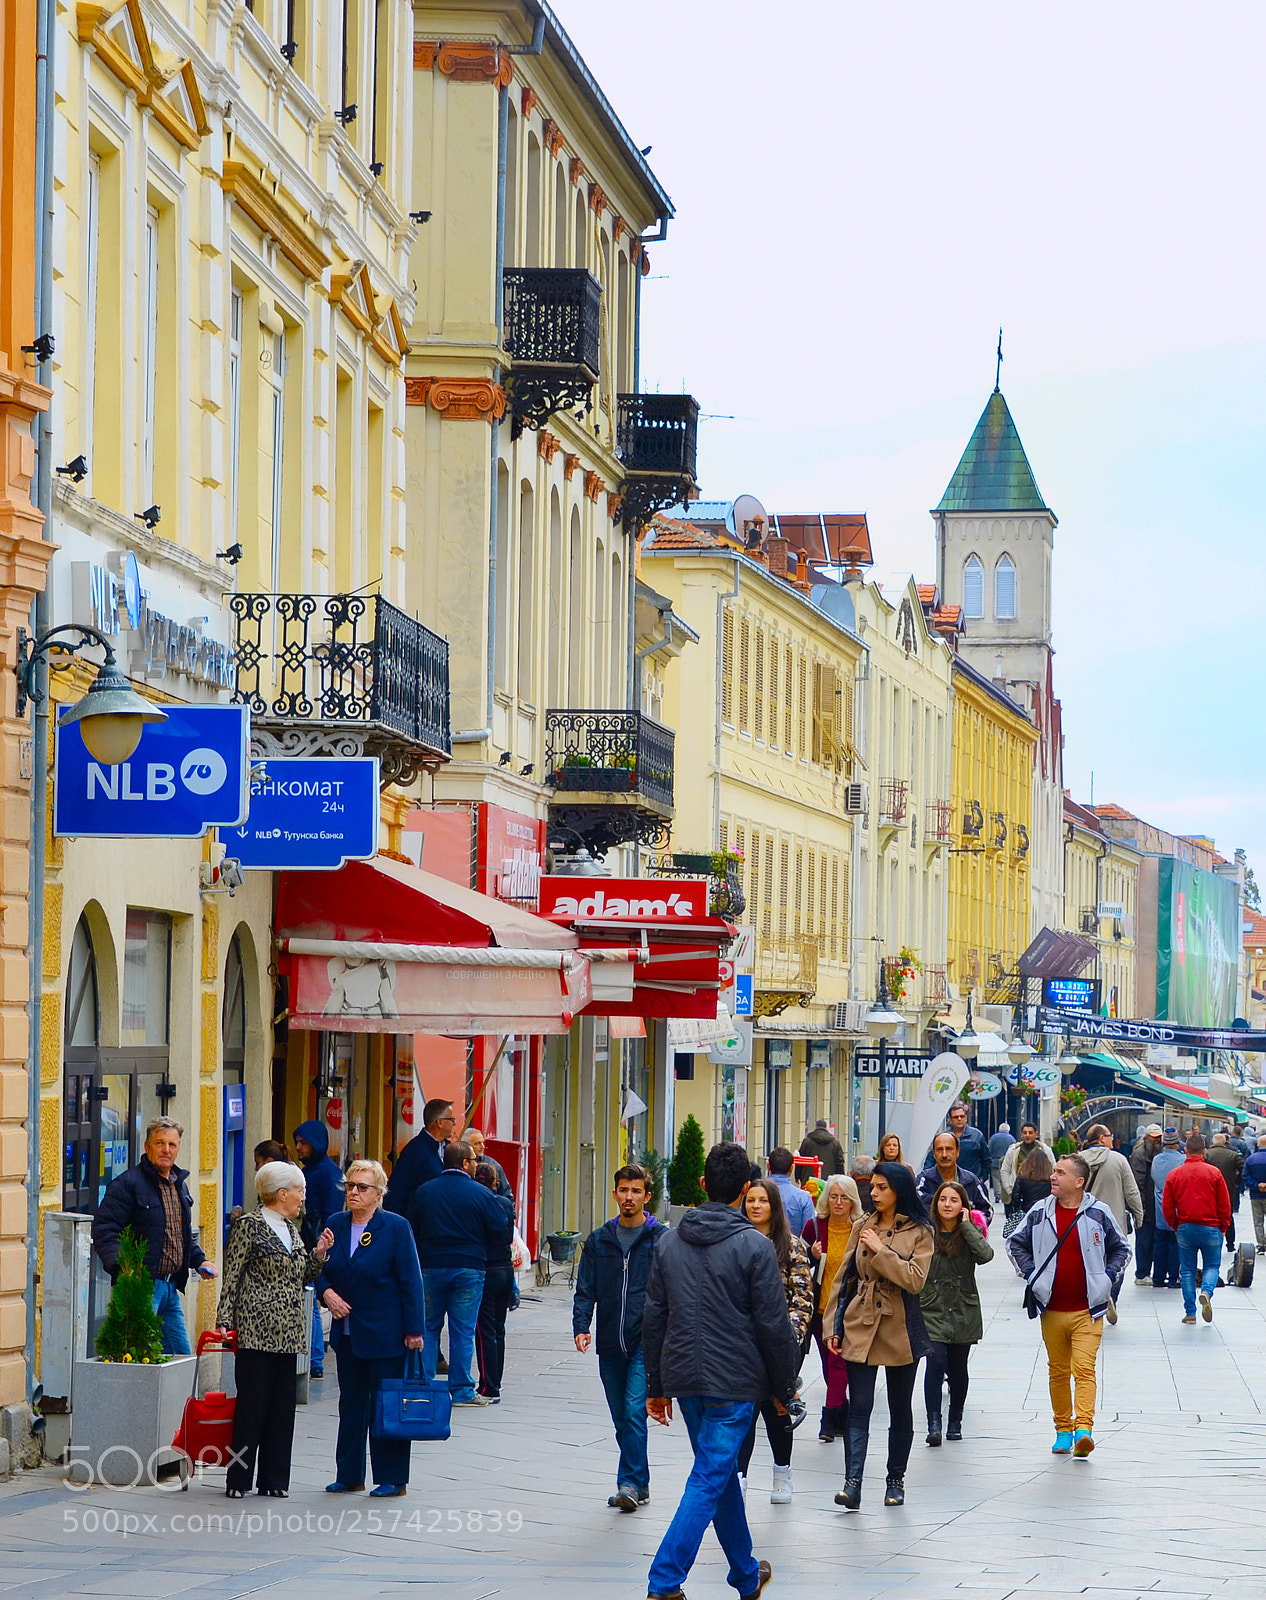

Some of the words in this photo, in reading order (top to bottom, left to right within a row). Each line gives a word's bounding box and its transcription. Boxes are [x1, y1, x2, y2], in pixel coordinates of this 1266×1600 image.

[86, 762, 176, 801] NLB
[250, 781, 344, 797] анкомат
[321, 801, 345, 813] 24ч
[255, 830, 273, 840] NLB
[283, 830, 319, 842] Тутунска
[319, 830, 344, 840] банка
[552, 890, 693, 917] adam's
[446, 970, 503, 980] СОВРШЕНИ
[505, 970, 547, 982] ЗАЕДНО
[1071, 1018, 1123, 1037] JAMES
[1127, 1024, 1175, 1042] BOND
